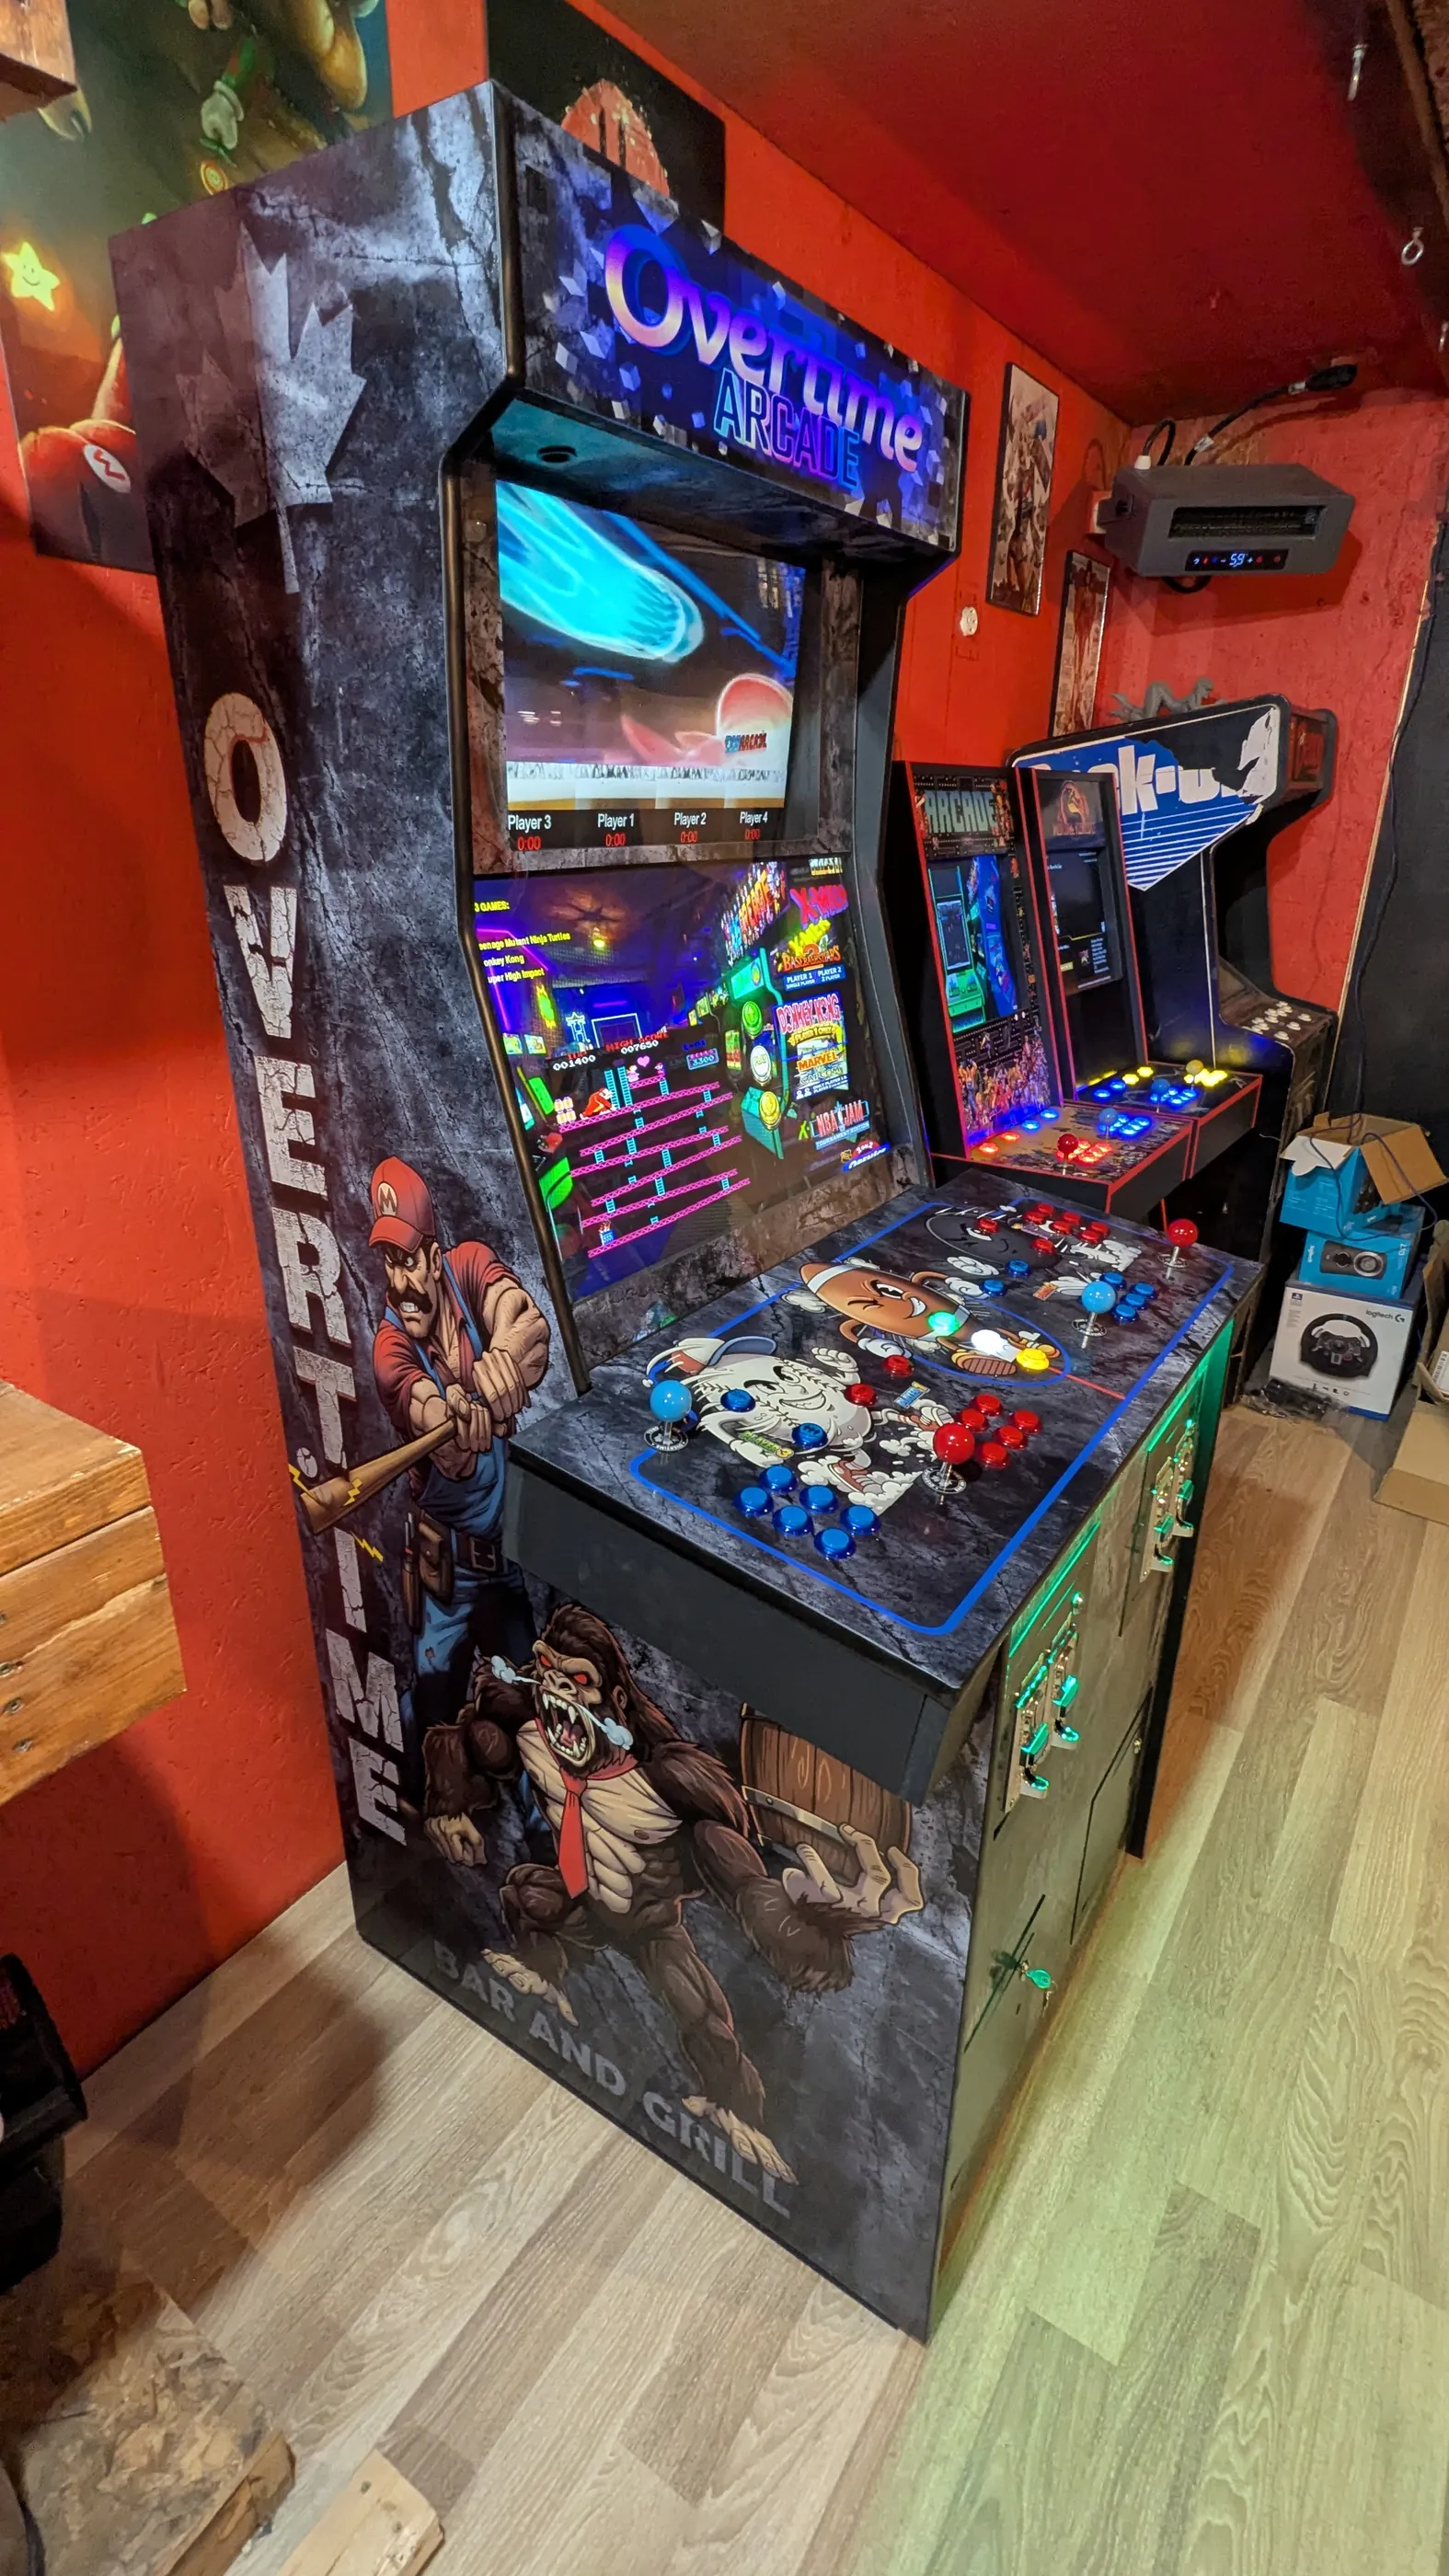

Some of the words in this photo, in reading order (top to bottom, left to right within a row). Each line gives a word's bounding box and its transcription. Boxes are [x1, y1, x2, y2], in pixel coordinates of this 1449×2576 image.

[713, 367, 862, 490] ARCADE
[674, 812, 700, 827] Player
[700, 811, 707, 826] 2
[740, 811, 762, 826] Player
[762, 811, 768, 824] 4
[924, 790, 999, 834] ARCADE
[508, 814, 544, 831] Player
[544, 814, 552, 830] 3
[598, 813, 627, 829] Player
[628, 812, 635, 827] 1
[605, 833, 627, 847] 0:00
[681, 831, 698, 844] 0:00
[744, 828, 761, 842] 0:00
[517, 836, 542, 851] 0:00
[480, 901, 511, 912] GAMES:
[478, 940, 504, 951] eenage
[504, 937, 530, 949] Mutant
[530, 935, 547, 946] Ninja
[547, 932, 571, 943] Turtles
[483, 956, 505, 967] onkey
[506, 954, 524, 965] Kong
[488, 974, 505, 984] uper
[505, 971, 522, 982] High
[522, 968, 545, 979] Impact
[787, 973, 808, 983] PLAYER
[818, 968, 837, 977] PLAYER
[776, 999, 813, 1035] DONKEY
[813, 994, 840, 1024] KONG
[605, 1040, 633, 1052] HIGH
[638, 1031, 669, 1043] SCORE
[620, 1040, 659, 1054] 007650
[553, 1054, 596, 1071] 001400
[692, 1054, 715, 1067] 3300
[797, 1051, 838, 1072] MARVEL
[816, 1110, 838, 1137] NBA
[844, 1099, 865, 1127] JAM
[1365, 1309, 1394, 1321] logitech
[433, 1940, 515, 2023] BAR
[528, 2010, 627, 2097] AND
[643, 2091, 791, 2220] GRILL
